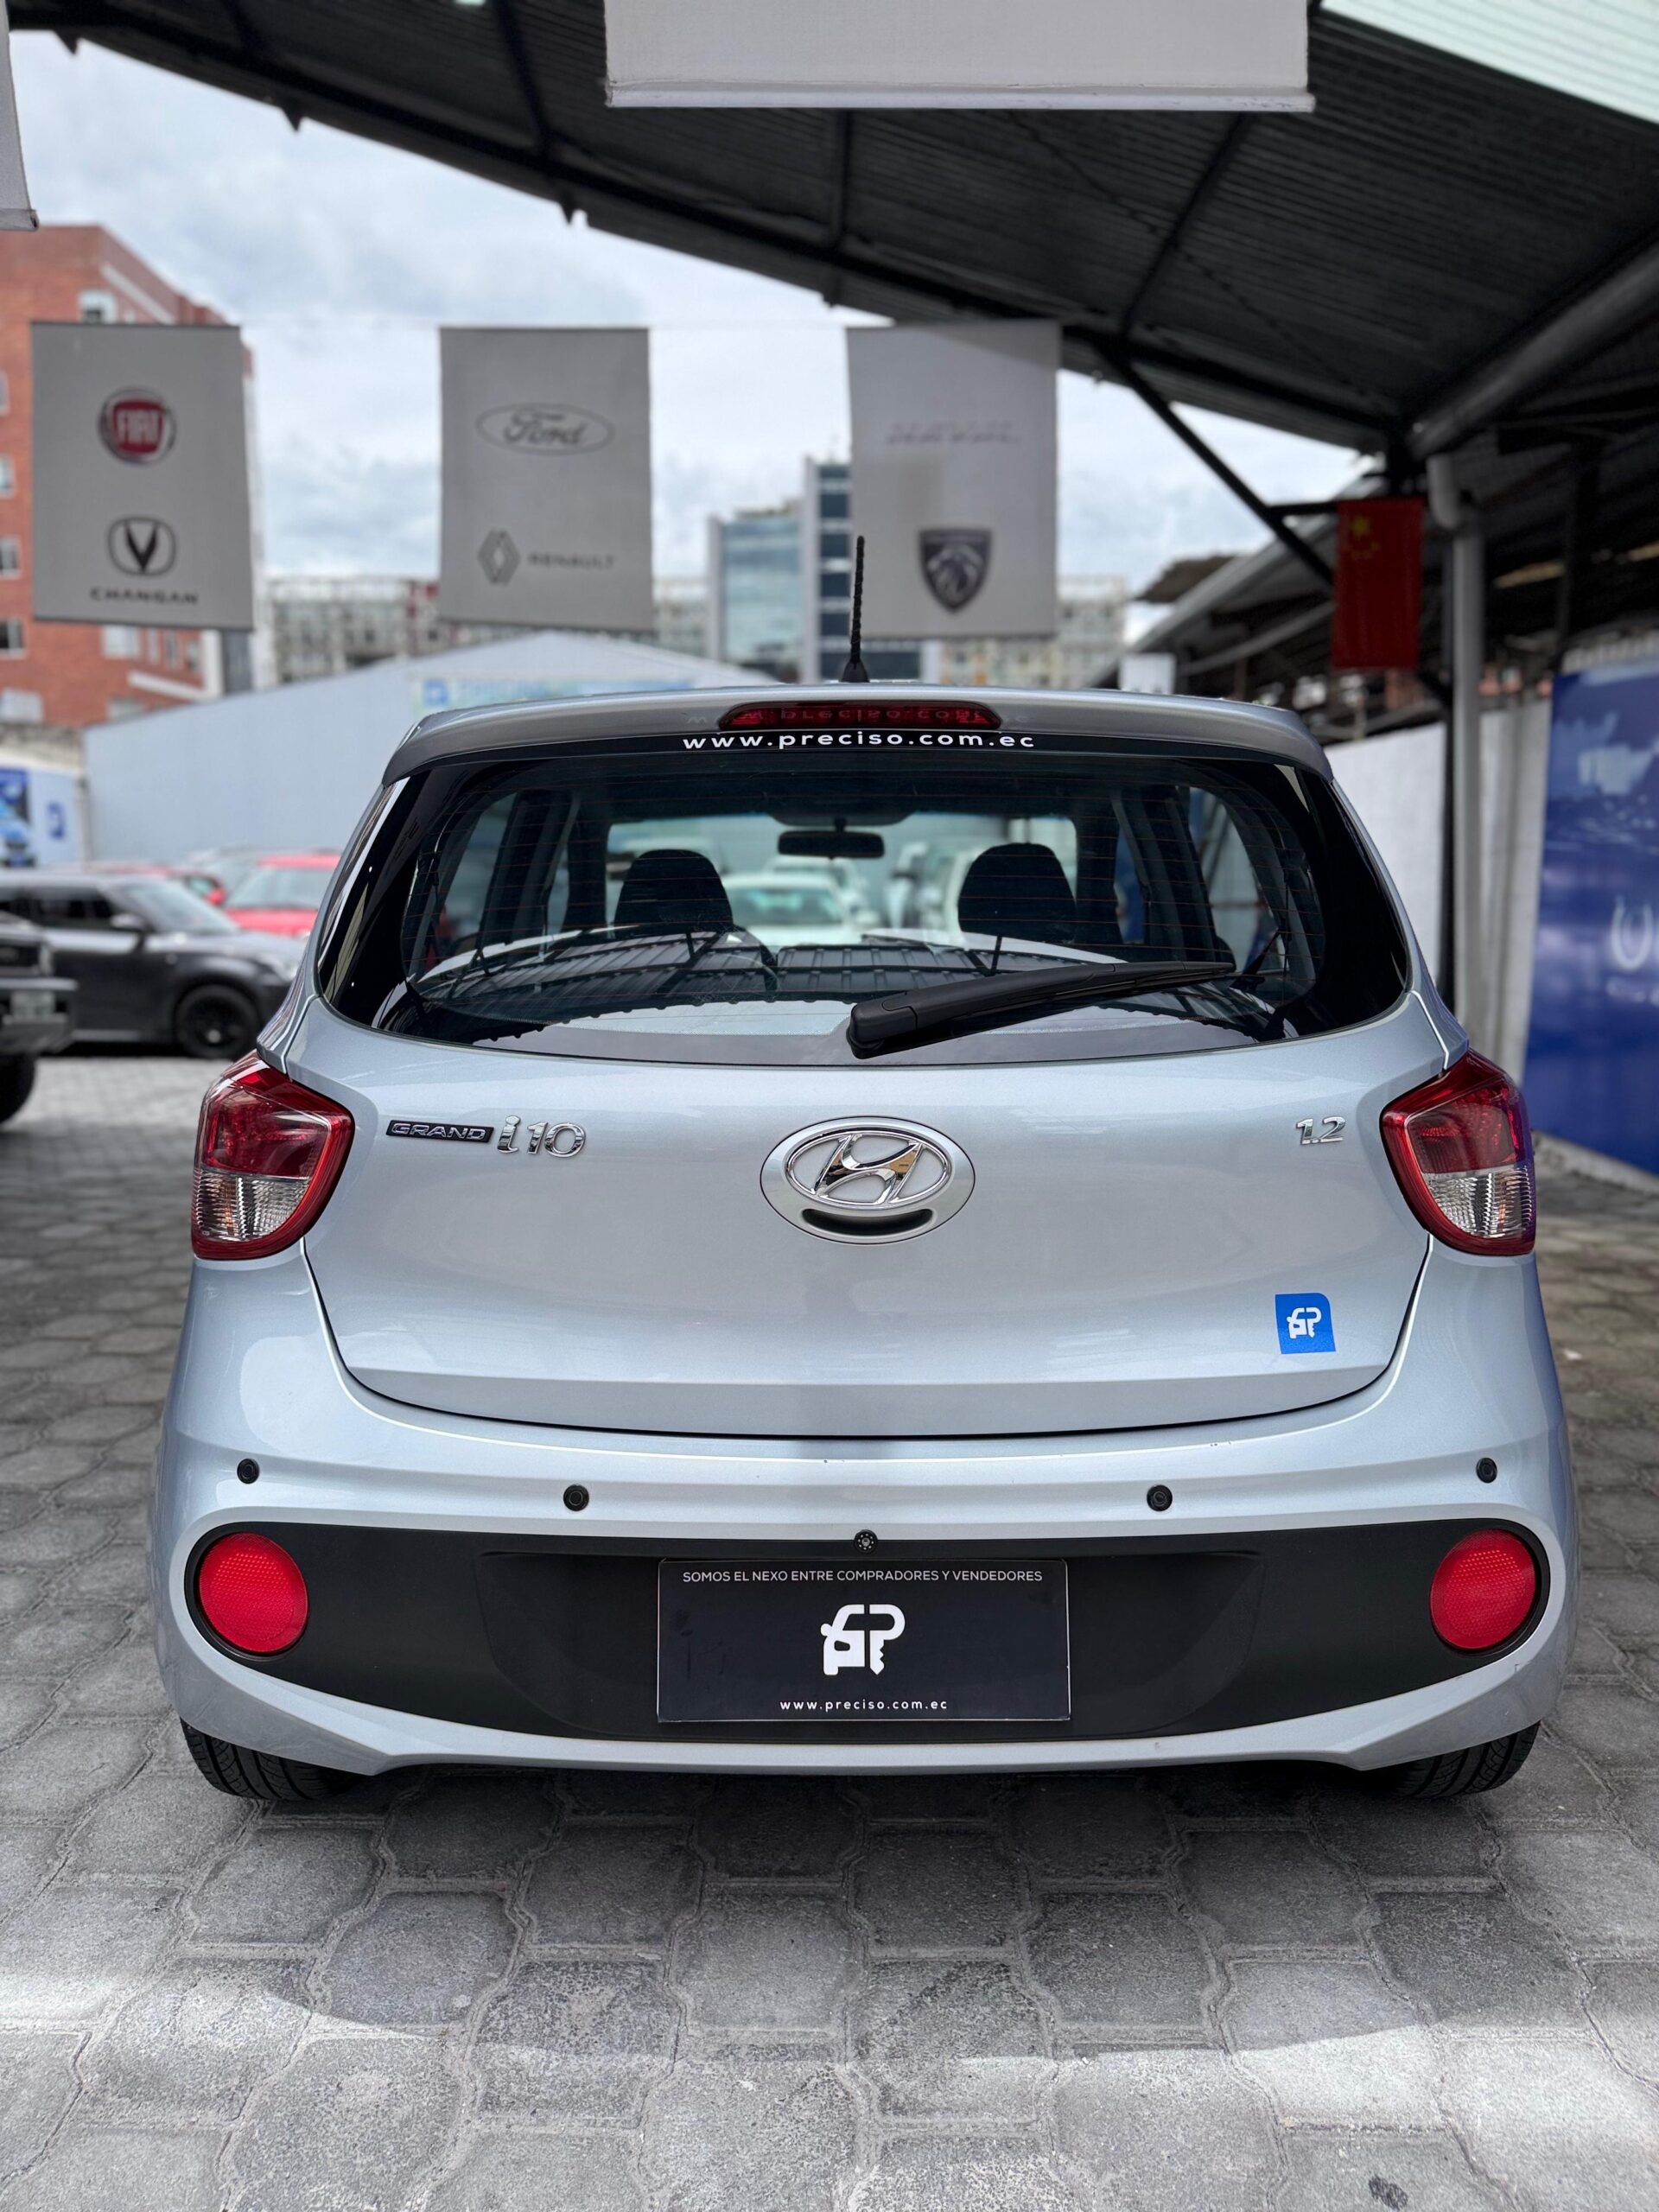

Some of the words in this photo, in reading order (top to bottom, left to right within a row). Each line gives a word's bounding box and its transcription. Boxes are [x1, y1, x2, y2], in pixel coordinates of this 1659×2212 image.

[115, 409, 162, 444] FIAT
[503, 409, 588, 446] Ford
[89, 586, 198, 605] CHANGAN
[683, 731, 1034, 749] www.preciso.com.ec
[390, 1121, 489, 1141] GRAND
[497, 1115, 587, 1158] i10
[1296, 1116, 1345, 1145] 1.2
[683, 1571, 731, 1583] SOMOS
[734, 1571, 749, 1582] EL
[752, 1570, 788, 1581] NEXO
[791, 1570, 834, 1581] ENTRE
[836, 1570, 939, 1581] COMPRADORES
[941, 1570, 950, 1580] Y
[952, 1570, 1043, 1581] VENDEDORES
[779, 1699, 948, 1713] www.preciso.com.ec
